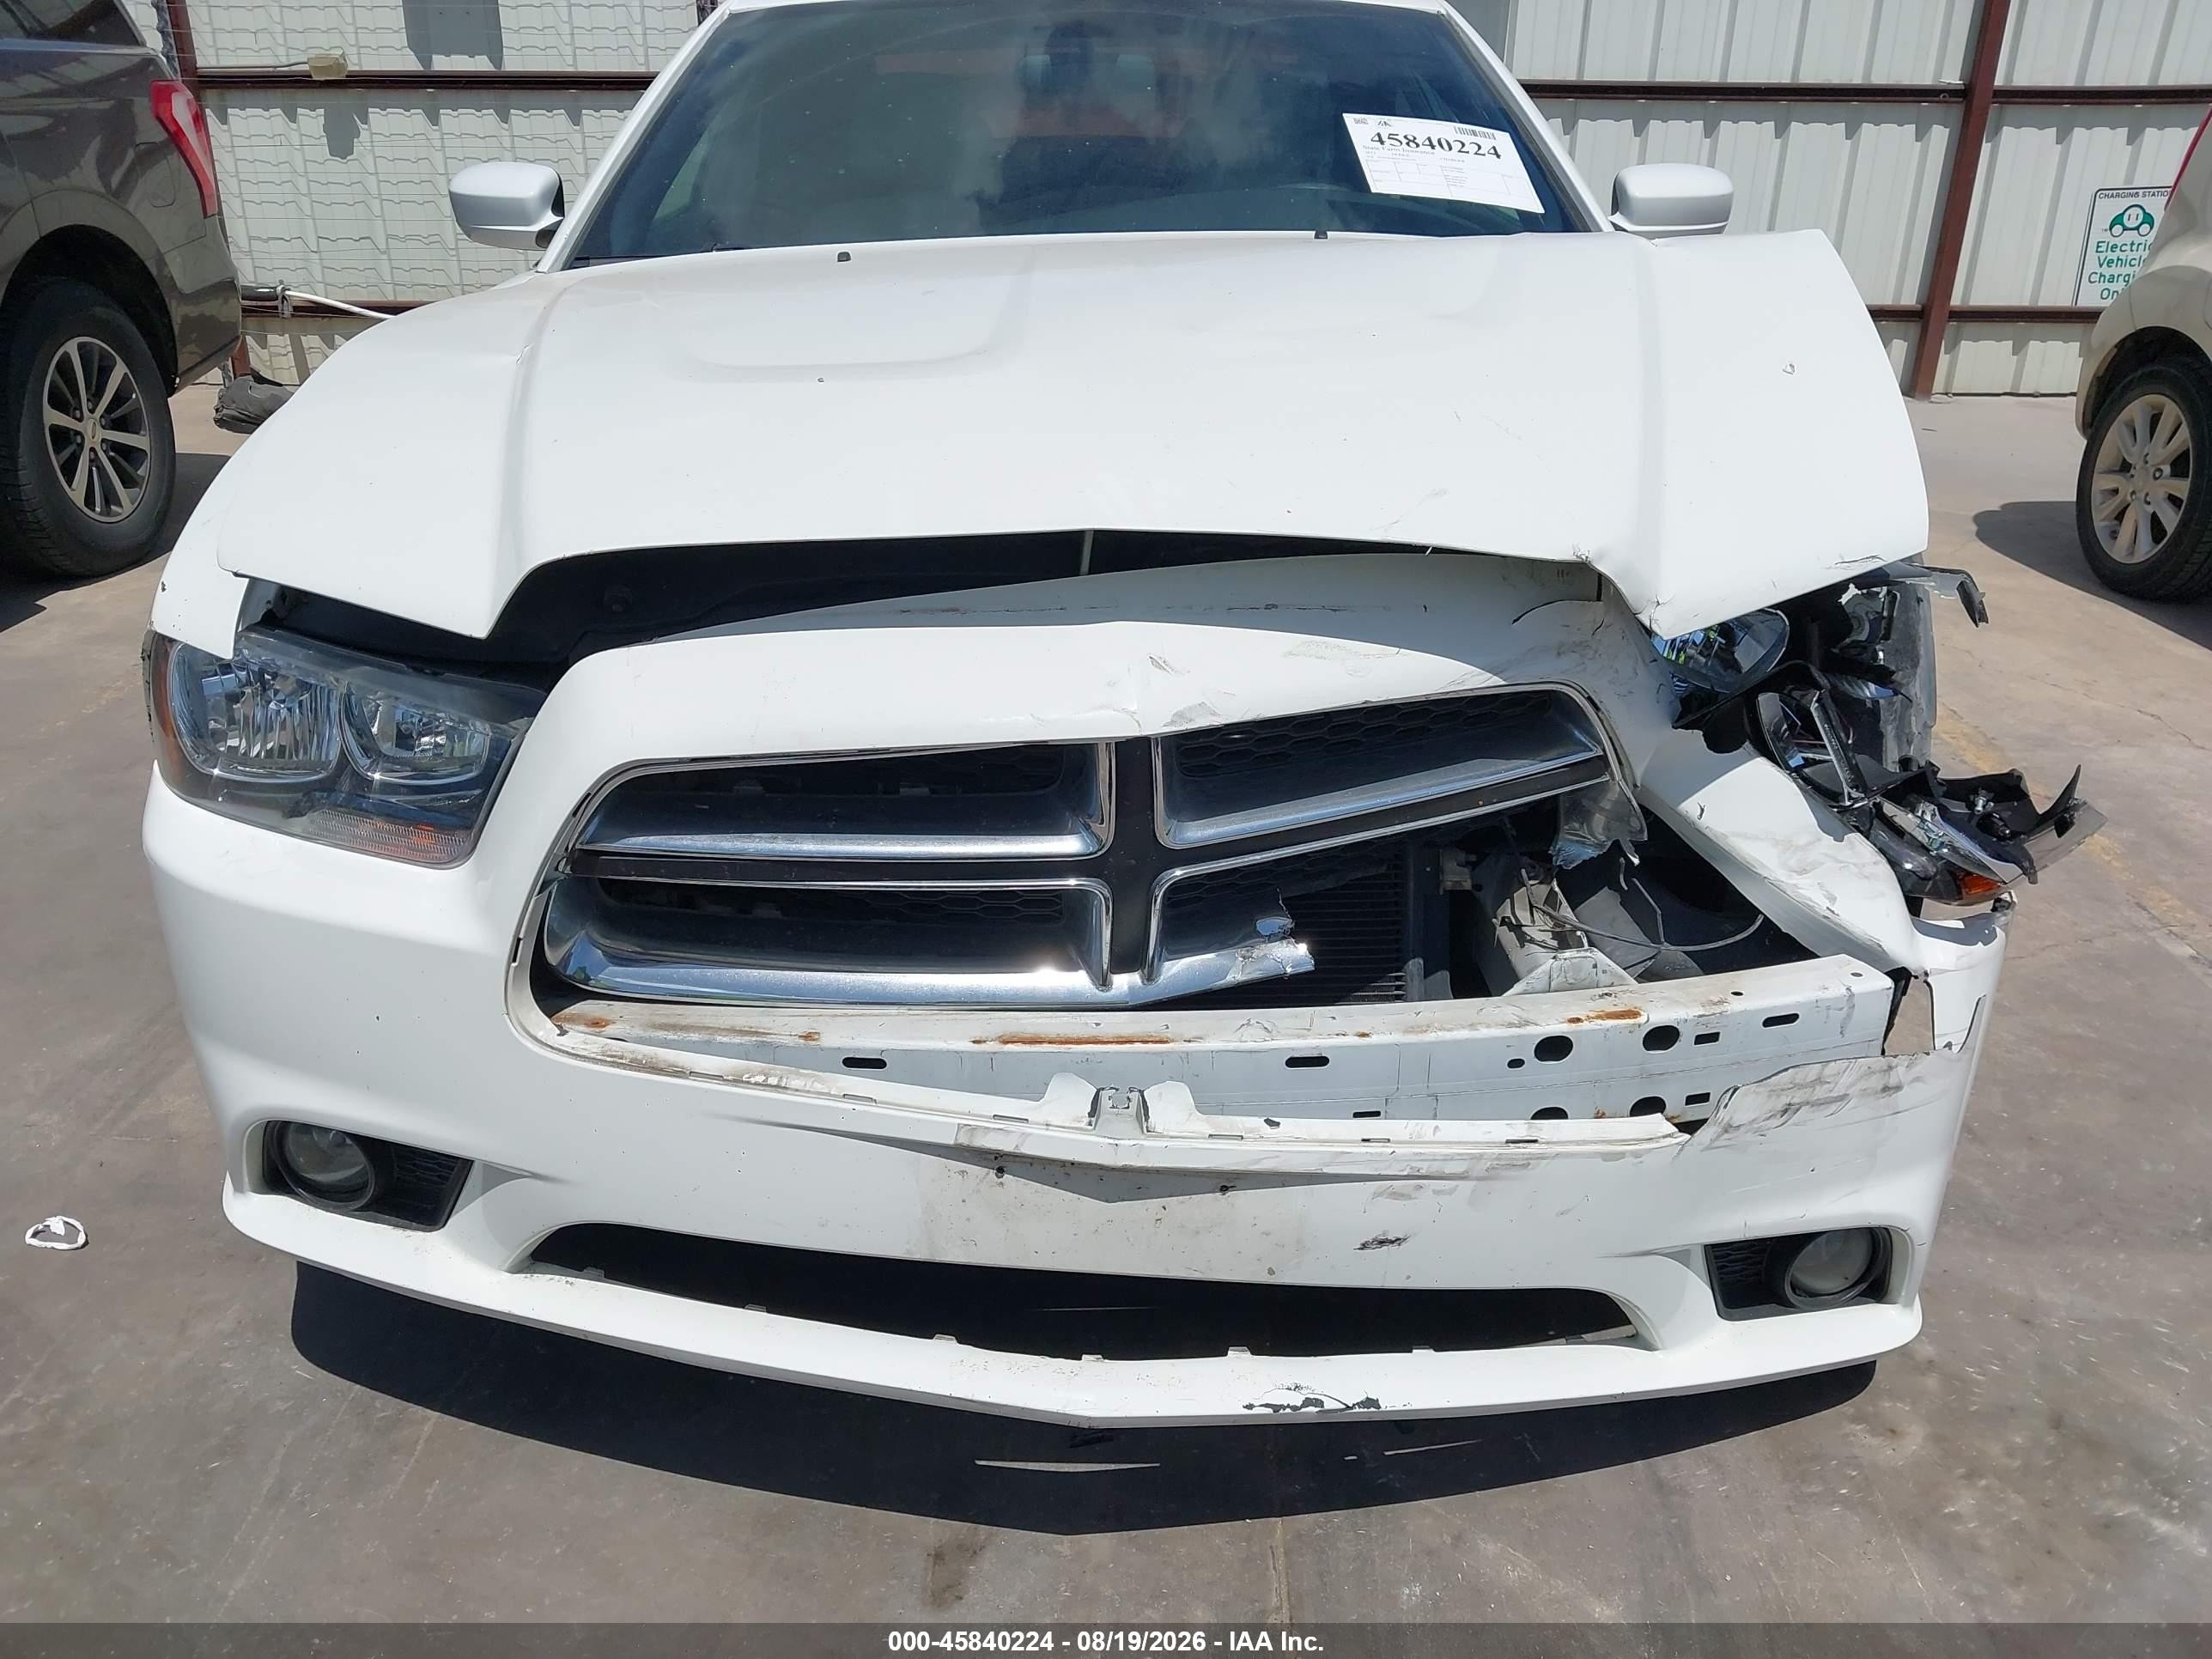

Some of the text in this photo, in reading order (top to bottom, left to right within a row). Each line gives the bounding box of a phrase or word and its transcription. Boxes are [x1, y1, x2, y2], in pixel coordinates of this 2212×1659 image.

[1370, 131, 1502, 160] 45840224
[2142, 190, 2171, 198] STATIO
[2087, 270, 2136, 287] Chargi
[2100, 287, 2124, 301] On
